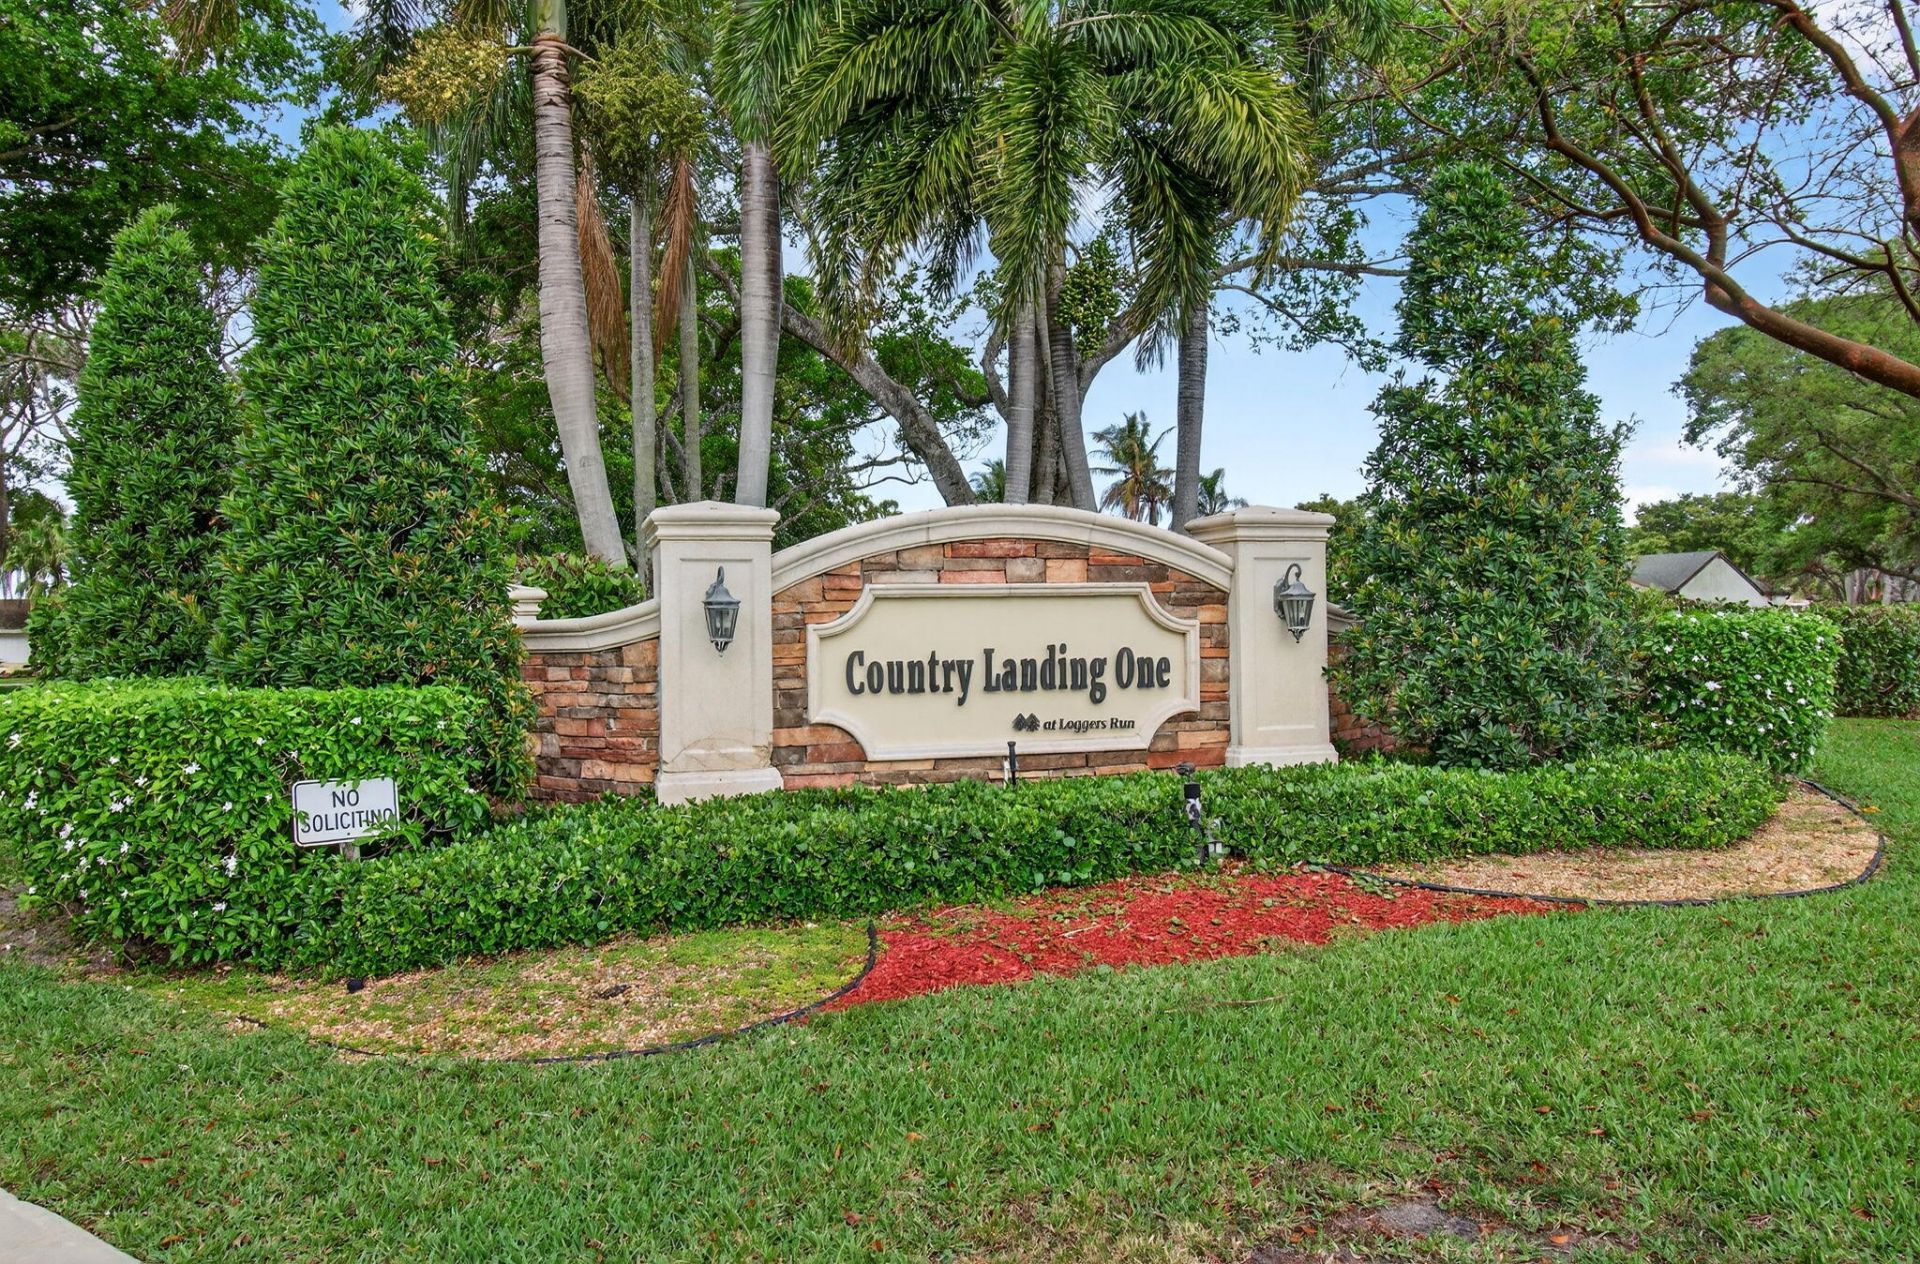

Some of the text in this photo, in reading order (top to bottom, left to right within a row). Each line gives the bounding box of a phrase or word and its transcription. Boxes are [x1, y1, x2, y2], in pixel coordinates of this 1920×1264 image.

[846, 643, 1171, 706] Country Landing One
[1043, 717, 1136, 733] at Loggers Run
[332, 789, 360, 808] NO
